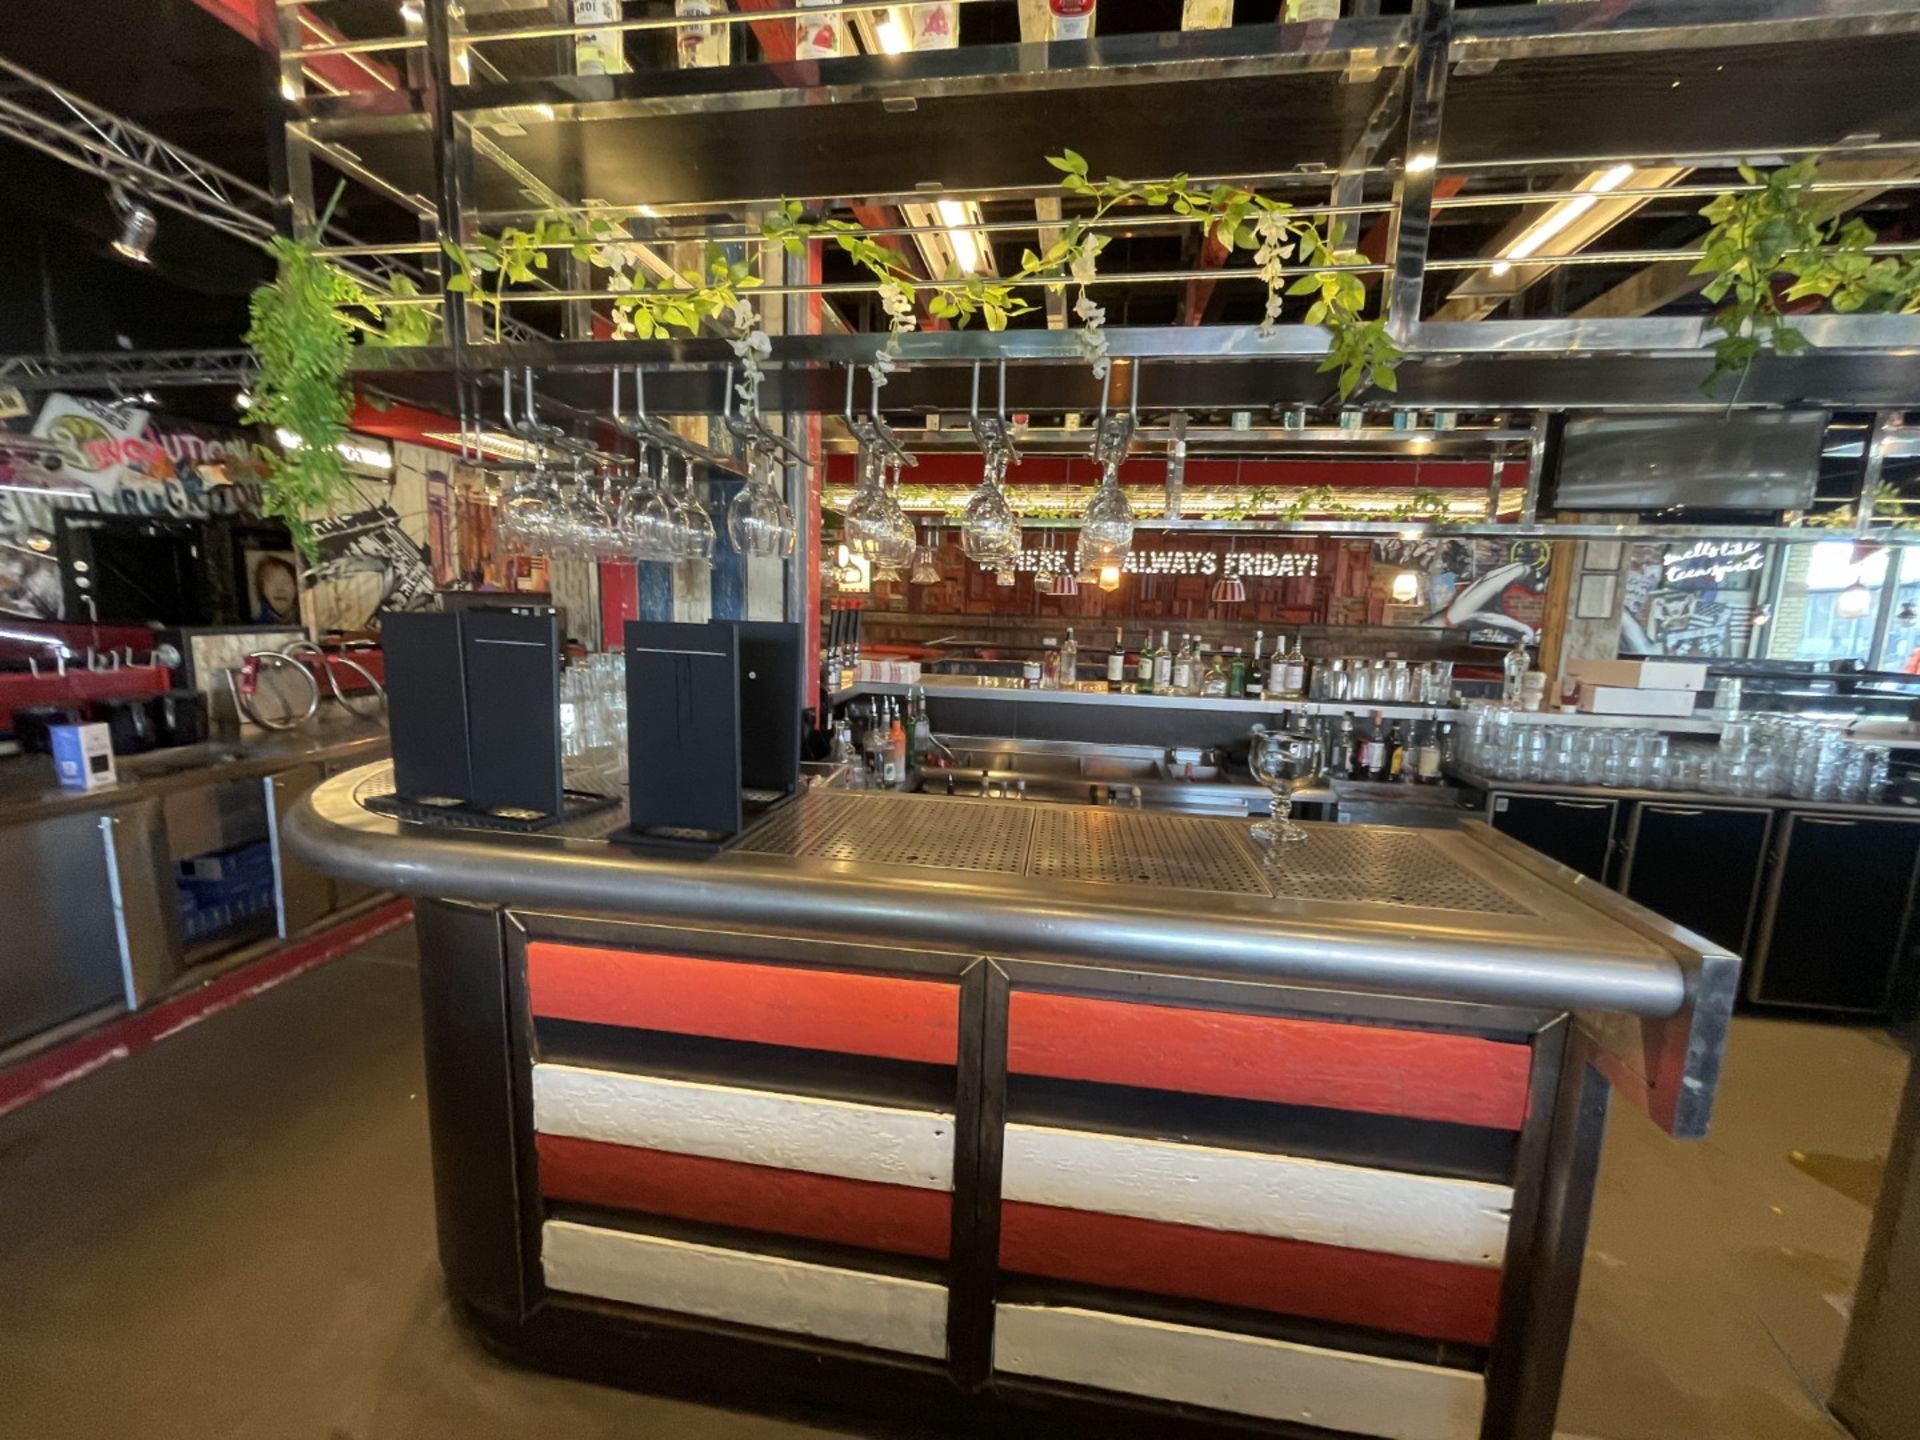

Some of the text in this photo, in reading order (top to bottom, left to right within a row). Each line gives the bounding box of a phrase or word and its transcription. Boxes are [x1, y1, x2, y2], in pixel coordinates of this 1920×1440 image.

[980, 549, 1070, 573] HERE
[1122, 551, 1217, 575] ALWAYS
[1224, 552, 1319, 577] FRIDAY!
